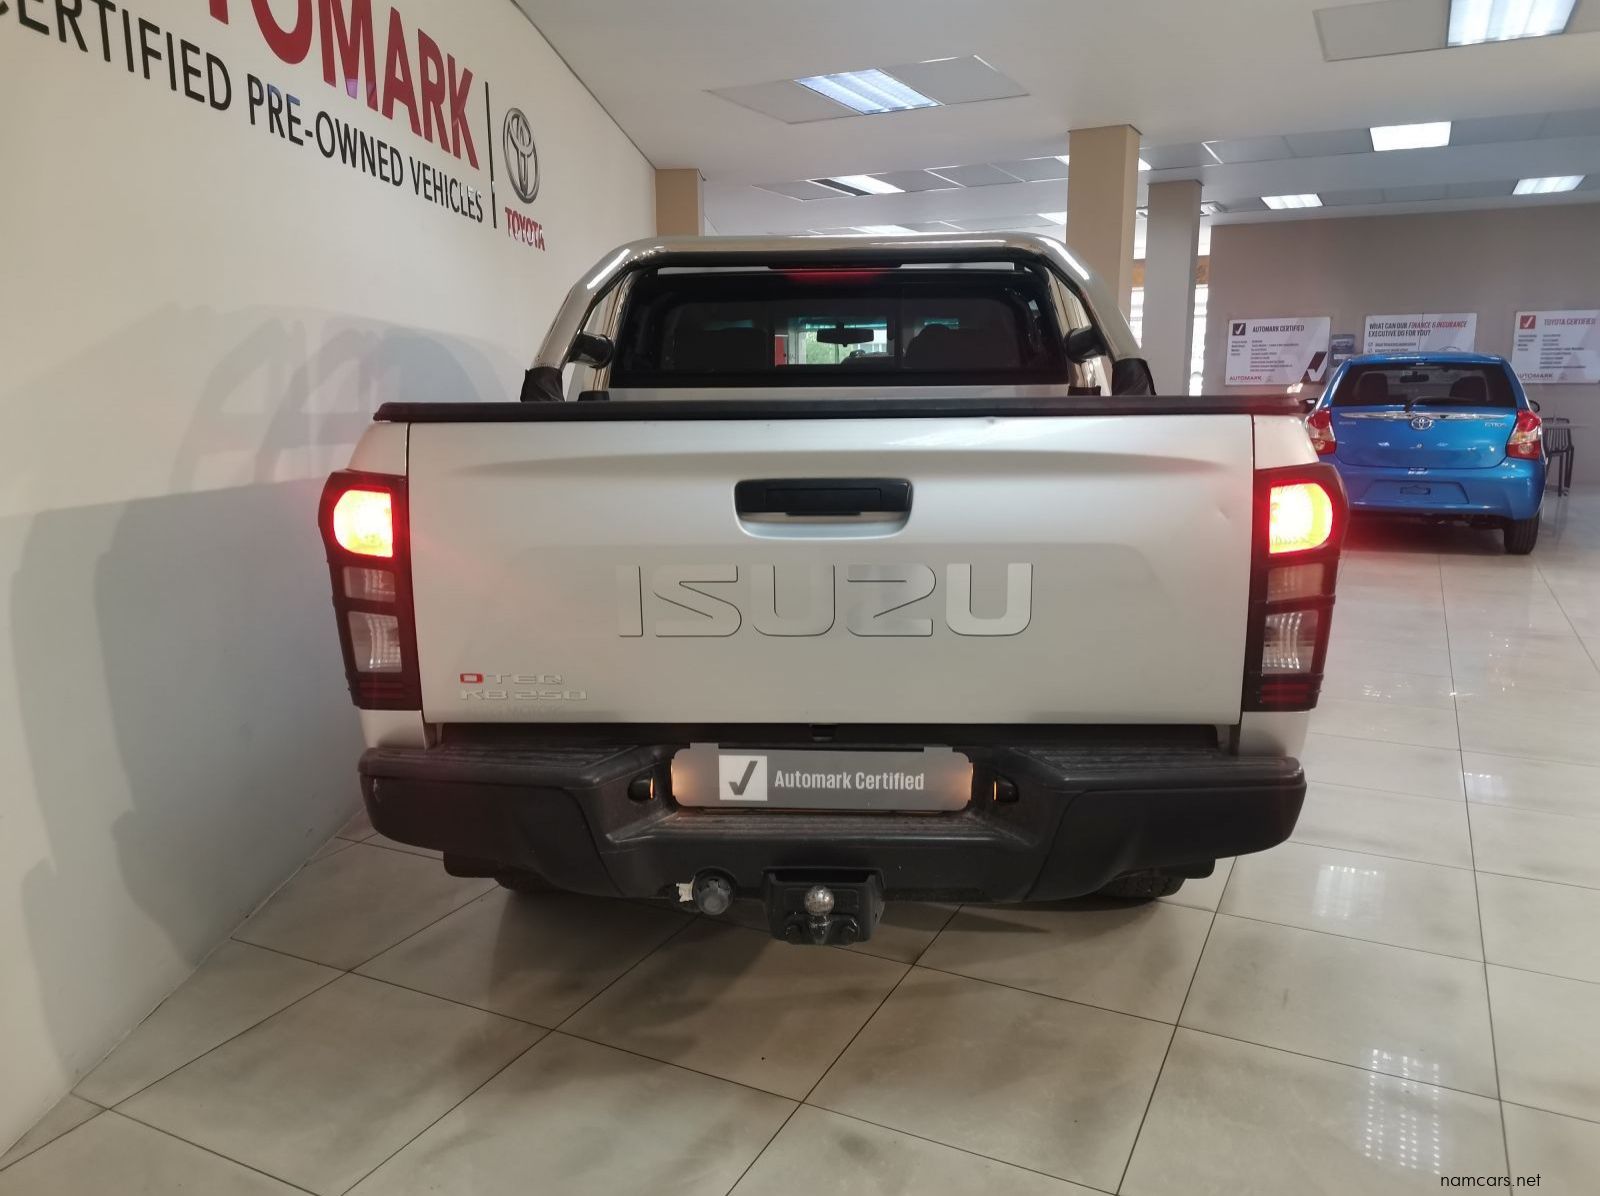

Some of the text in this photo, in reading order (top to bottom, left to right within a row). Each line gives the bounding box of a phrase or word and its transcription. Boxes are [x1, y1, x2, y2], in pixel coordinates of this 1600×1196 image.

[210, 0, 480, 170] OMARK
[0, 0, 484, 224] ERTIFIED PRE-OWNED VEHICLES
[505, 206, 545, 252] TOYOTA
[1252, 324, 1305, 333] AUTOMARK CERTIFIED
[1369, 322, 1385, 330] WHAT
[1385, 322, 1396, 330] CAN
[1408, 321, 1432, 329] FINANCE
[1435, 320, 1467, 329] INSURANCE
[1416, 329, 1431, 337] YOU?
[615, 562, 1034, 638] ISUZU
[461, 688, 588, 701] KB 250
[774, 769, 925, 791] Automark Certified
